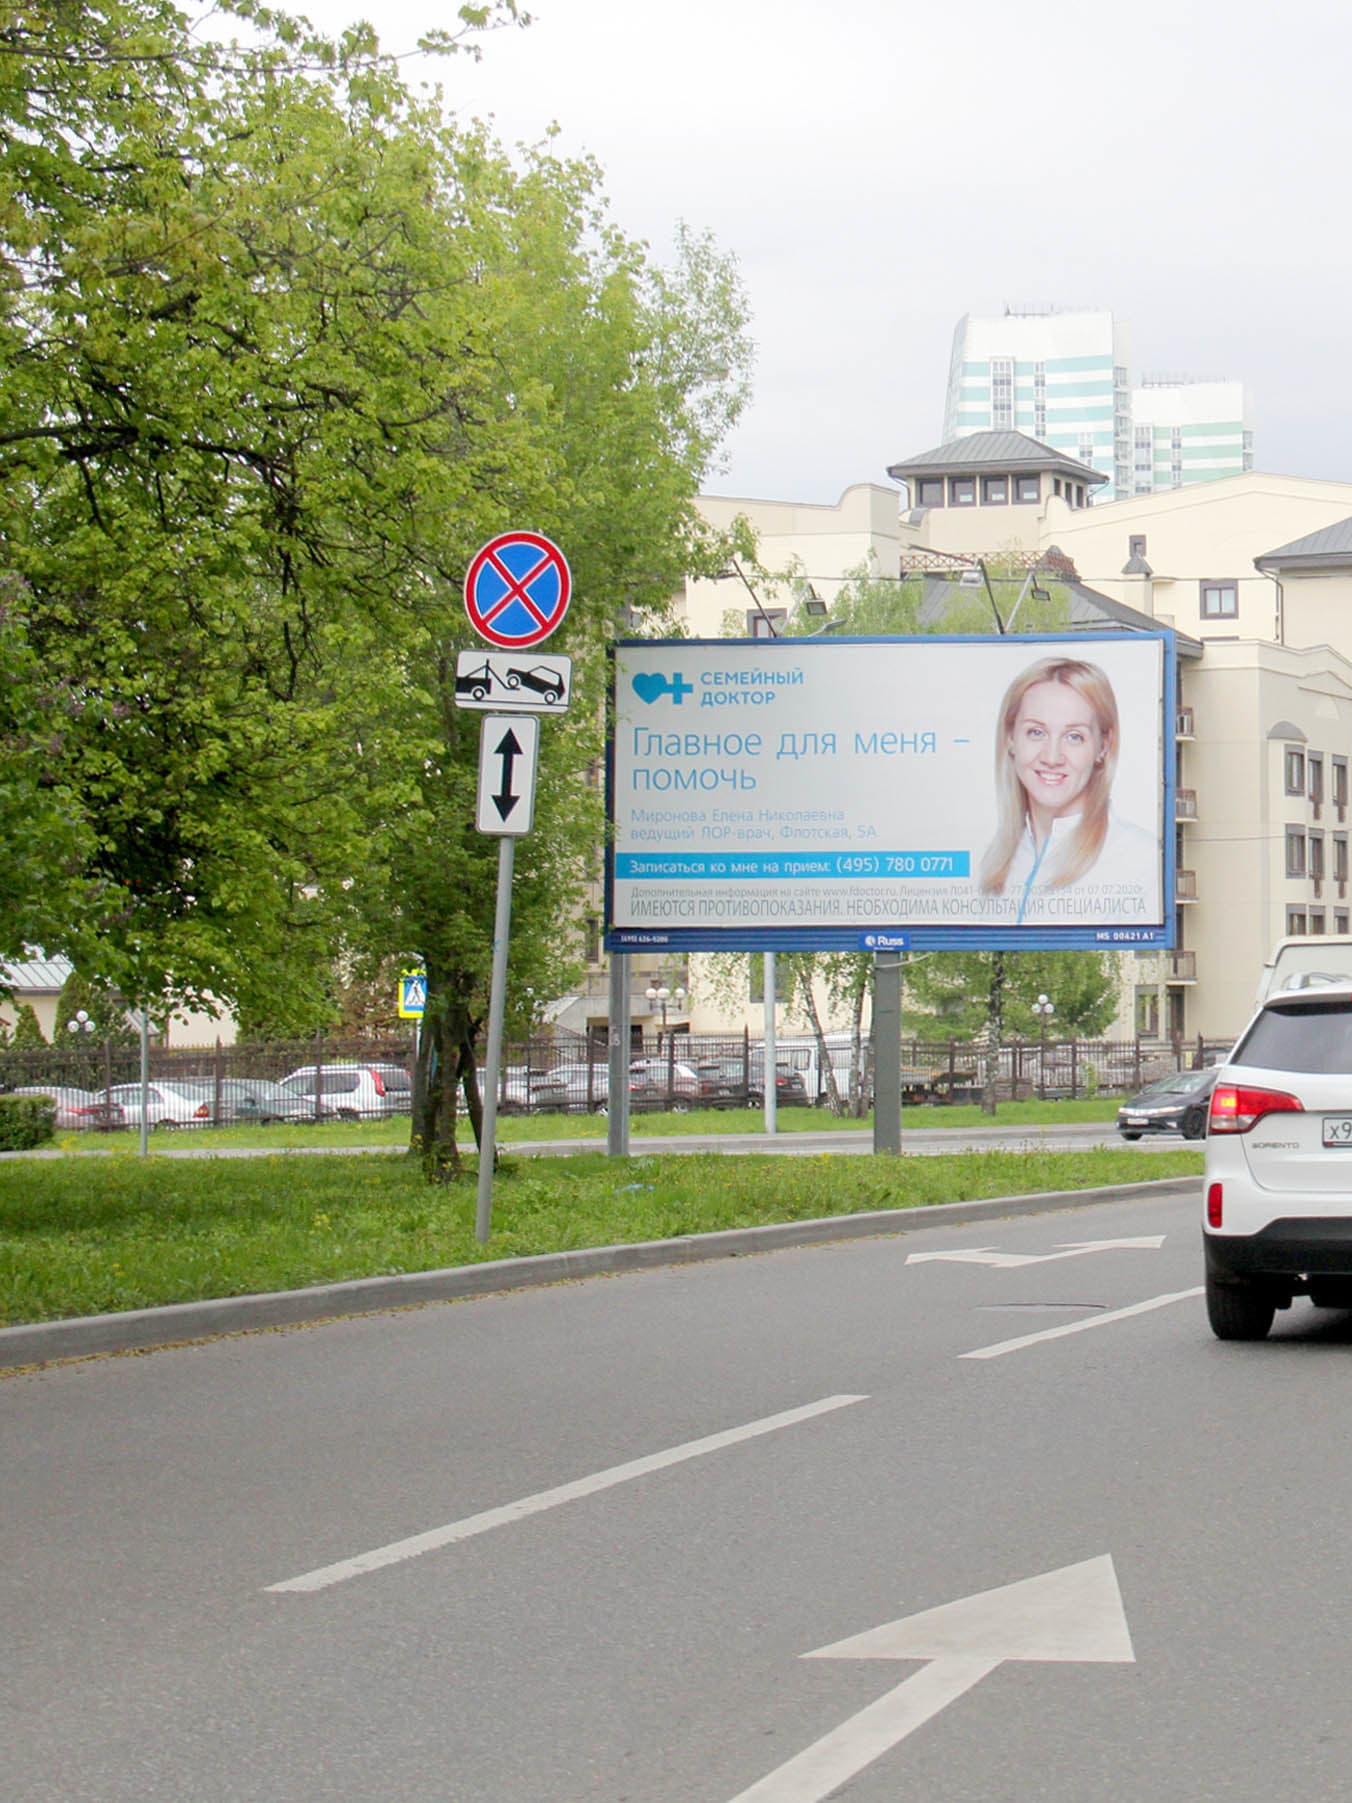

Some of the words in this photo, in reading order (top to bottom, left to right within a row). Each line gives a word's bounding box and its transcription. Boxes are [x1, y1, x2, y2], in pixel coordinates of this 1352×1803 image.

[700, 667, 804, 686] СЕМЕЙНЫЙ
[700, 690, 776, 708] ДОКТОР
[633, 726, 763, 757] Главное
[776, 731, 838, 761] для
[854, 731, 937, 755] меня
[632, 767, 757, 791] помочь
[631, 808, 707, 824] Миронова
[712, 808, 754, 822] Елена
[758, 808, 845, 822] Николаевна
[630, 827, 696, 842] ведущий
[780, 824, 853, 841] Флотская,
[629, 859, 706, 874] Записаться
[710, 861, 727, 874] ко
[730, 861, 759, 873] мне
[763, 860, 780, 872] на
[835, 855, 880, 874] (495)
[885, 856, 915, 873] 780
[920, 856, 954, 872] 0771
[715, 886, 779, 899] информация
[780, 888, 792, 897] на
[794, 886, 821, 897] сайте
[631, 899, 696, 917] ИМЕЮТСЯ
[698, 898, 843, 917] ПРОТИВОПОКАЗАНИЯ.
[846, 898, 938, 918] НЕОБХОДИМА
[942, 897, 1045, 919] КОНСУЛЬТАЦИЯ
[1047, 897, 1146, 918] СПЕЦИАЛИСТА
[877, 935, 905, 947] Russ
